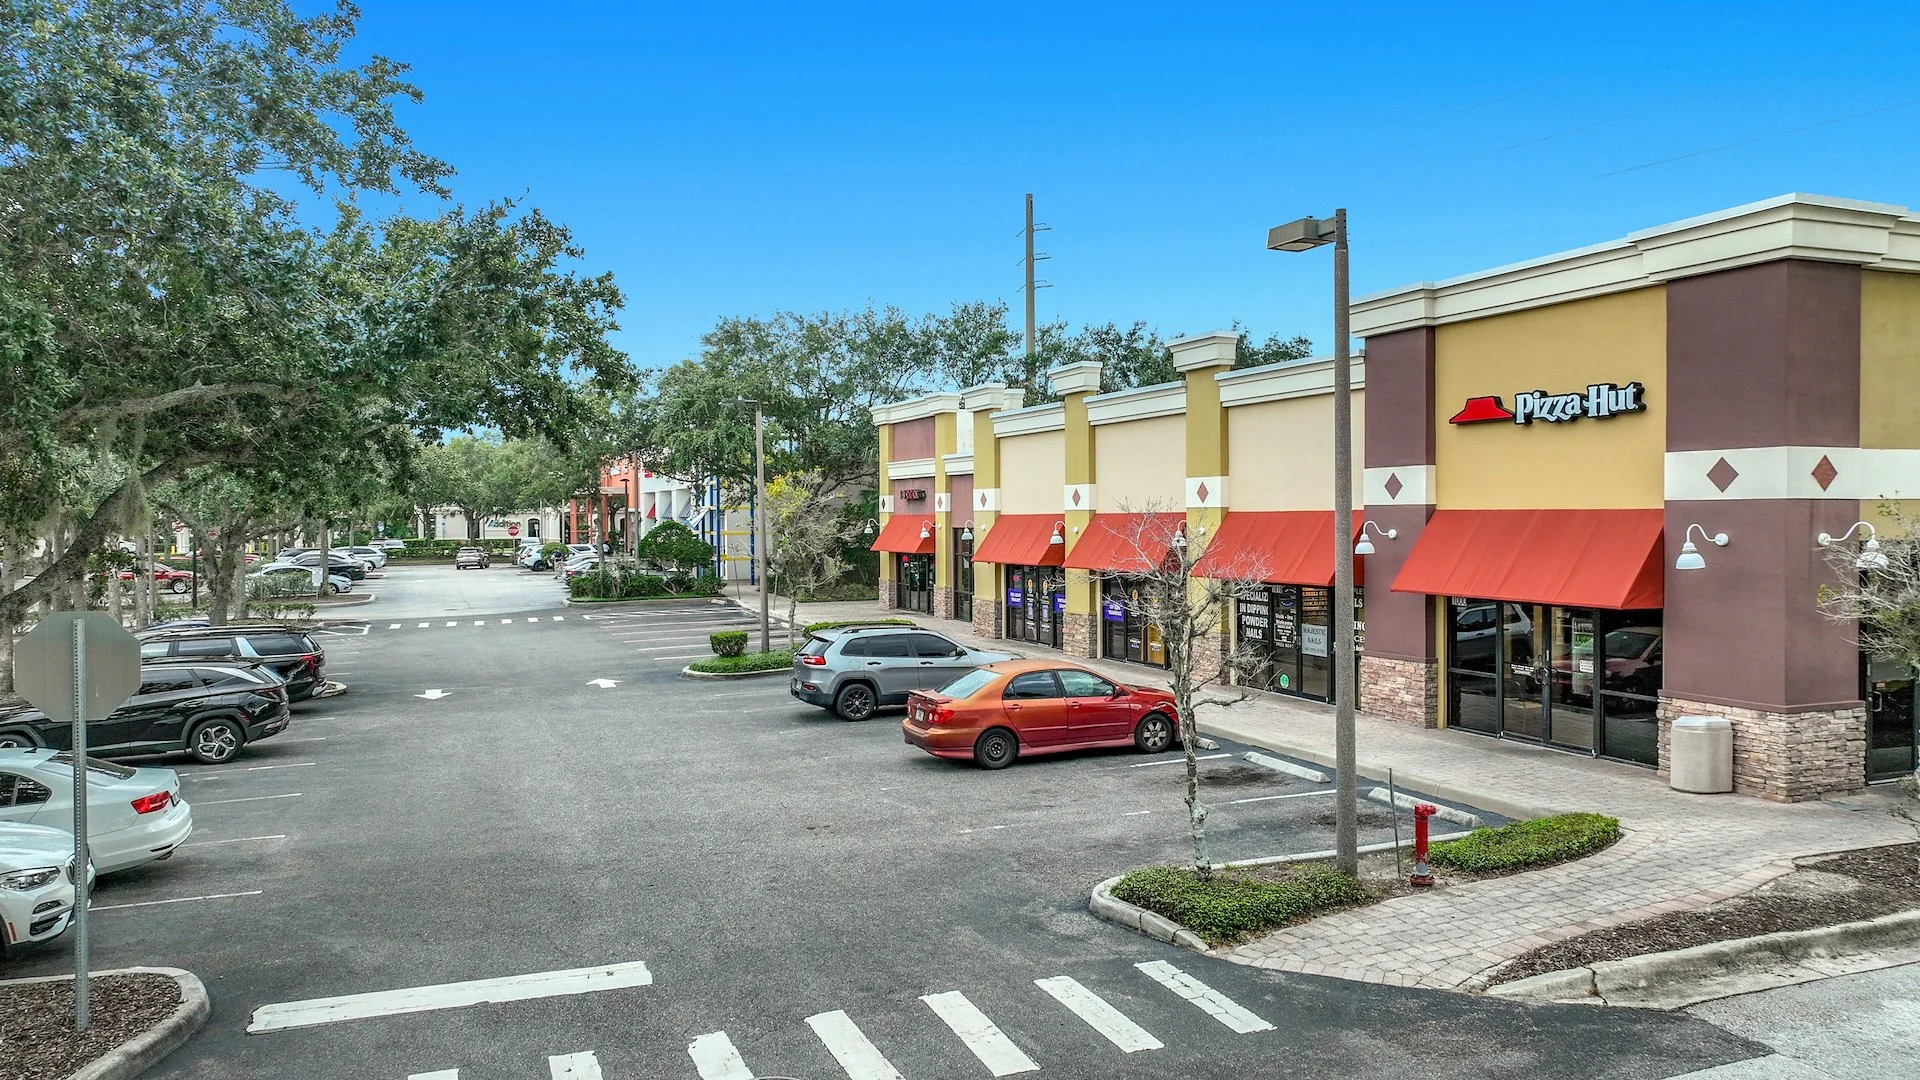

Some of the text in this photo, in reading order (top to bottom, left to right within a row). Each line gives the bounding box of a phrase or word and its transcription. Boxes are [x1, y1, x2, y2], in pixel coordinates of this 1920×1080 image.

[1515, 382, 1639, 424] Pizza Hut
[1240, 602, 1246, 613] IN
[1241, 614, 1269, 628] POWDER
[1245, 627, 1263, 640] NAILS
